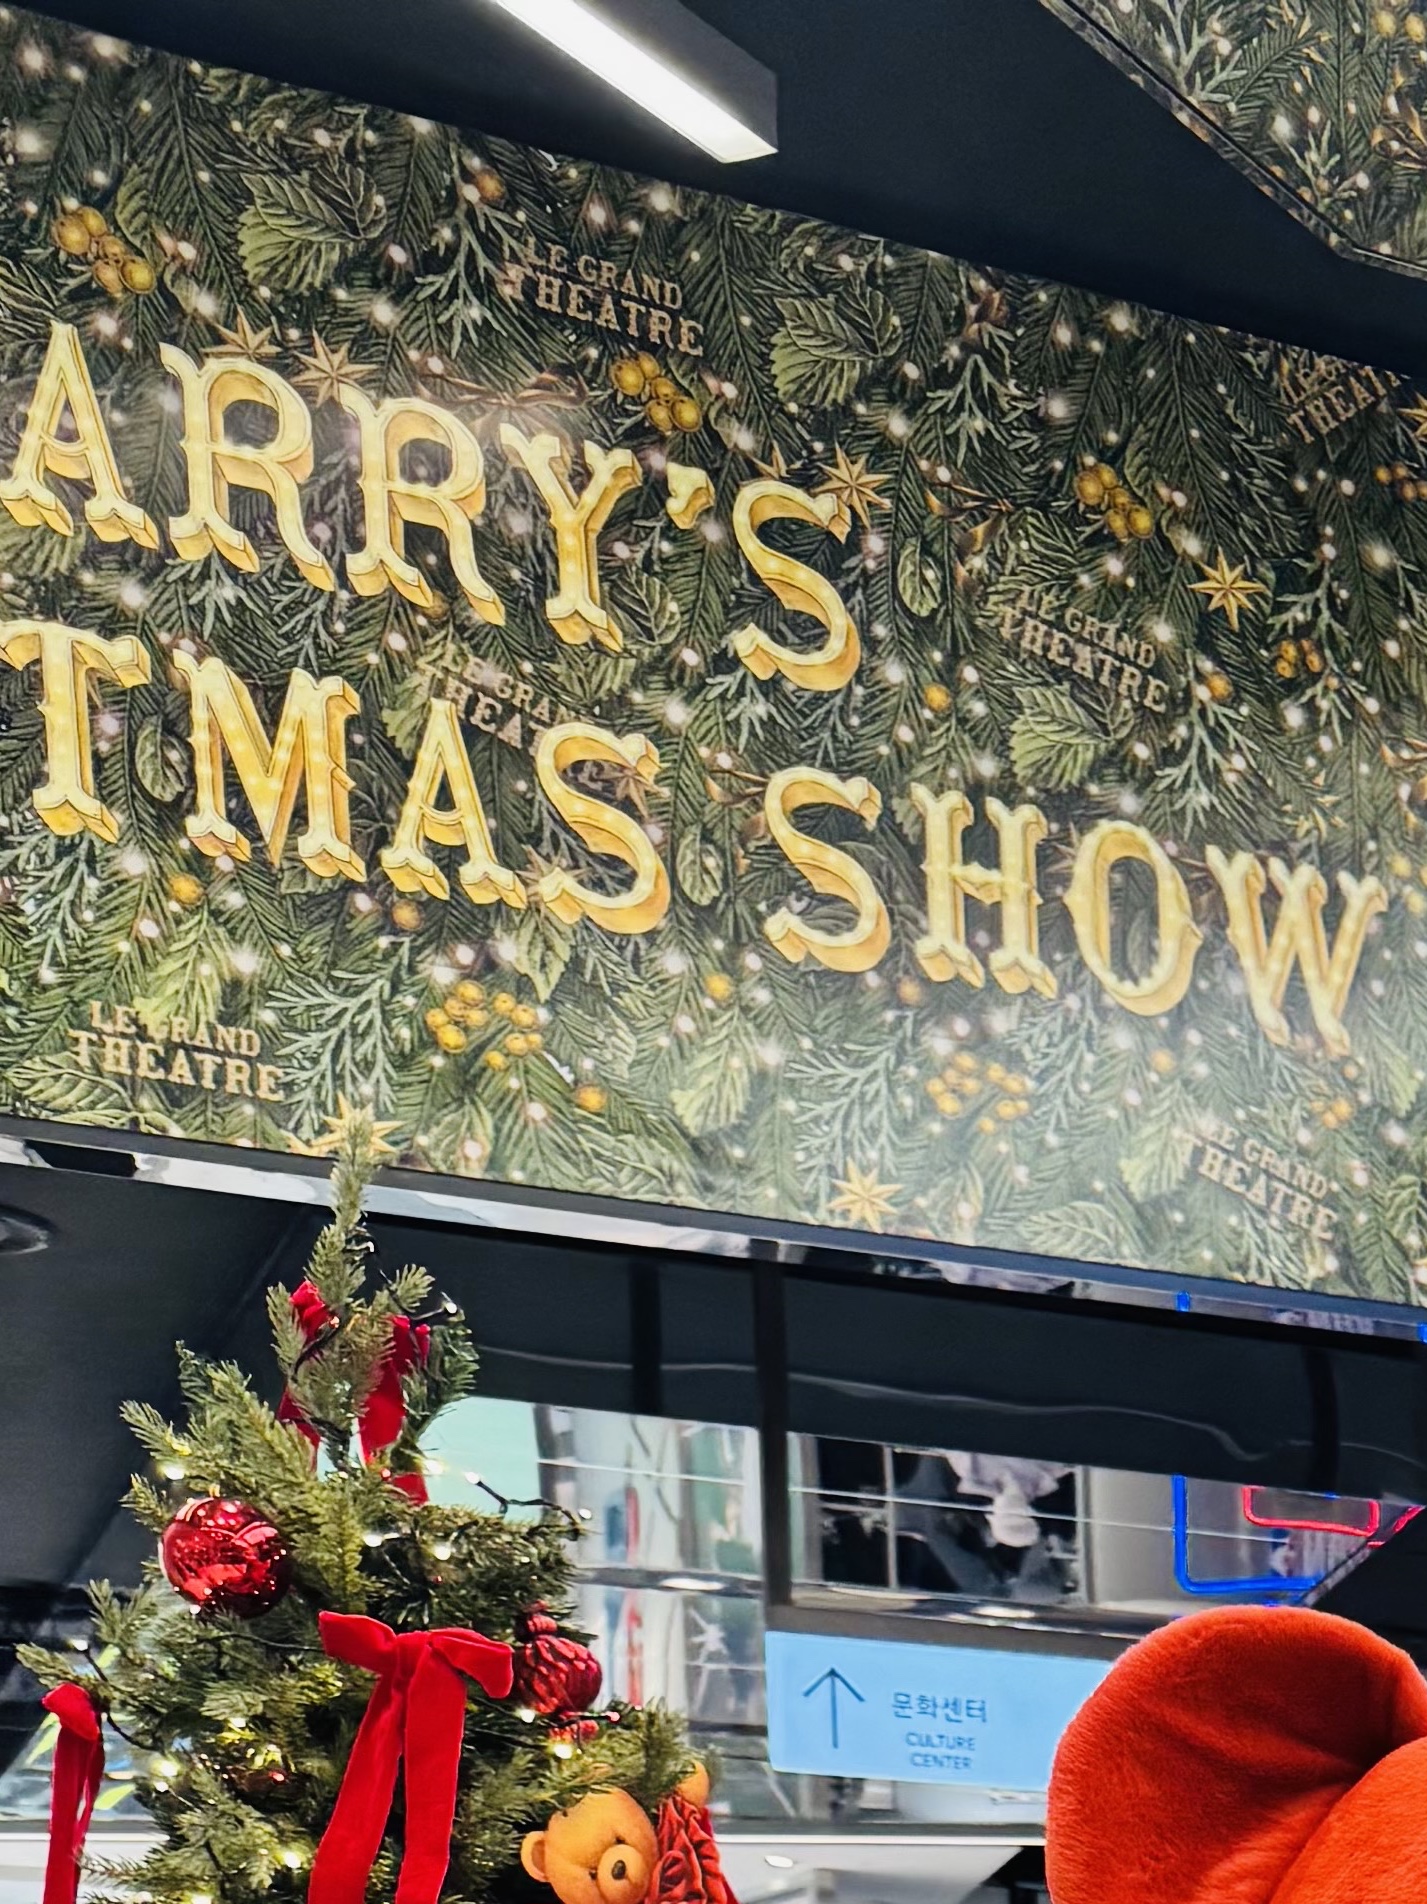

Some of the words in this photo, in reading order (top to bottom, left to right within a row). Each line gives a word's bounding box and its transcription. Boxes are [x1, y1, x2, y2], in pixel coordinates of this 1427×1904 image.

[499, 261, 704, 357] THEATRE
[524, 235, 568, 273] LE
[576, 254, 683, 311] GRAND
[0, 319, 863, 692] ARRY'S
[998, 604, 1170, 714] THEATRE
[1064, 607, 1156, 669] GRAND
[0, 617, 668, 933] TMAS
[764, 764, 1388, 1058] SHOW
[67, 1029, 286, 1102] THEATRE
[90, 1000, 138, 1035] LE
[146, 1012, 262, 1058] GRAND
[1176, 1129, 1339, 1241] THEATRE
[1242, 1138, 1329, 1200] GRAND
[891, 1691, 988, 1723] 문화센터
[904, 1731, 976, 1752] CULTURE
[910, 1752, 974, 1771] CENTER
